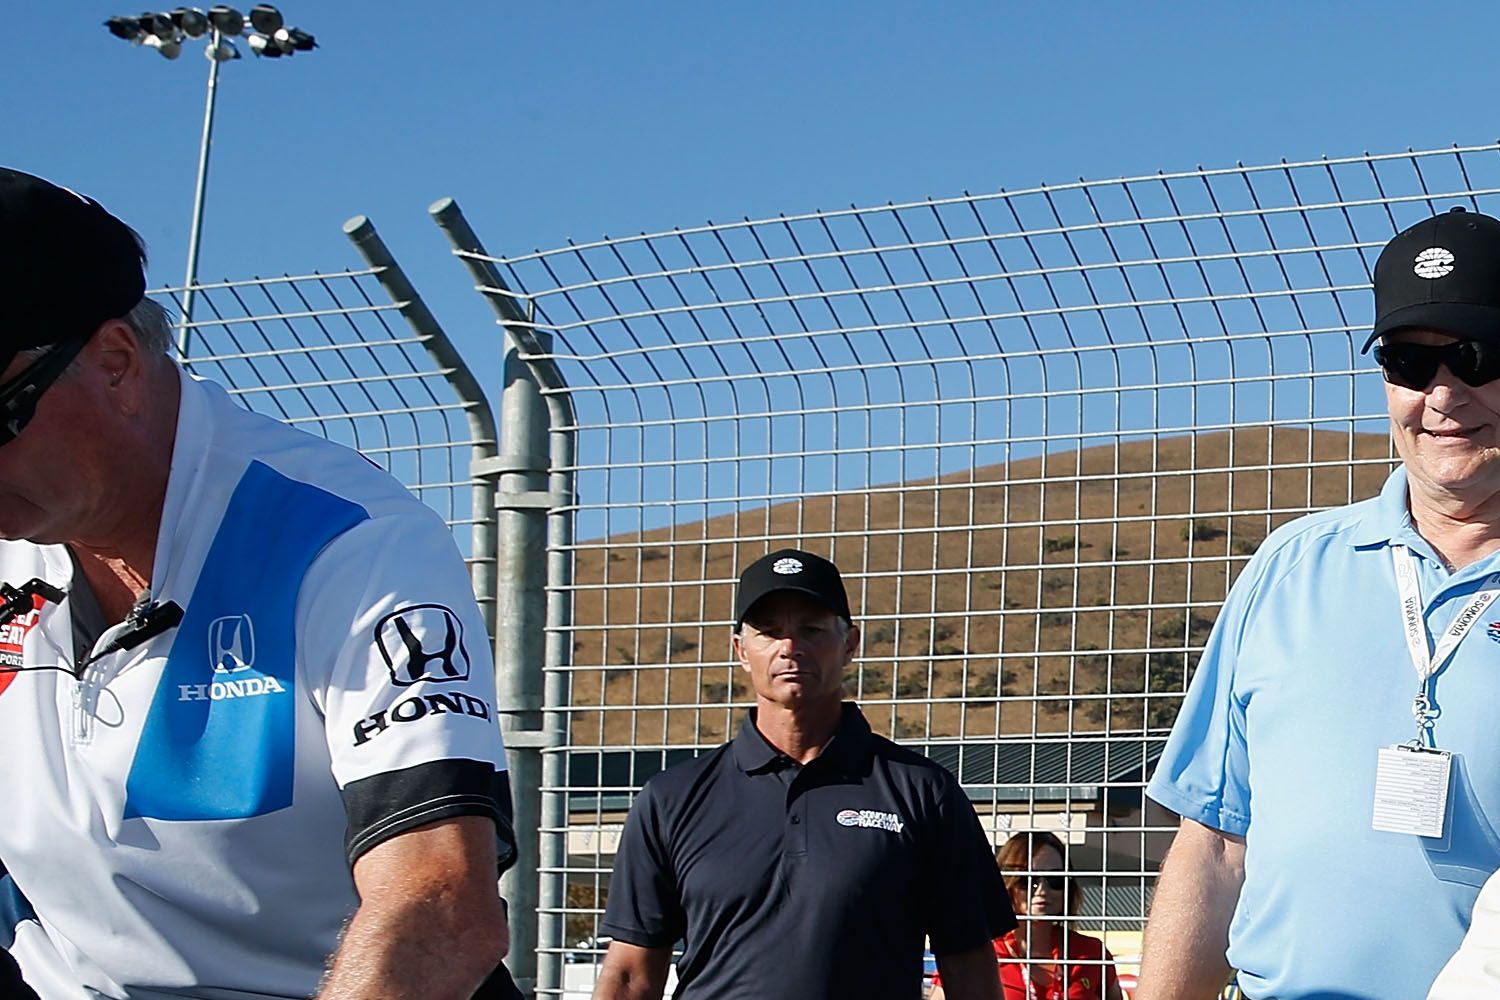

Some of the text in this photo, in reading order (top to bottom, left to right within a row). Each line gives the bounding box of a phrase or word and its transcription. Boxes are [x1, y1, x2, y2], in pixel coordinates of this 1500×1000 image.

[1450, 599, 1486, 637] SONOMA
[177, 675, 287, 702] HONDA
[352, 691, 492, 747] HOND
[858, 818, 904, 833] RACEWAY
[859, 809, 899, 826] SONOMA
